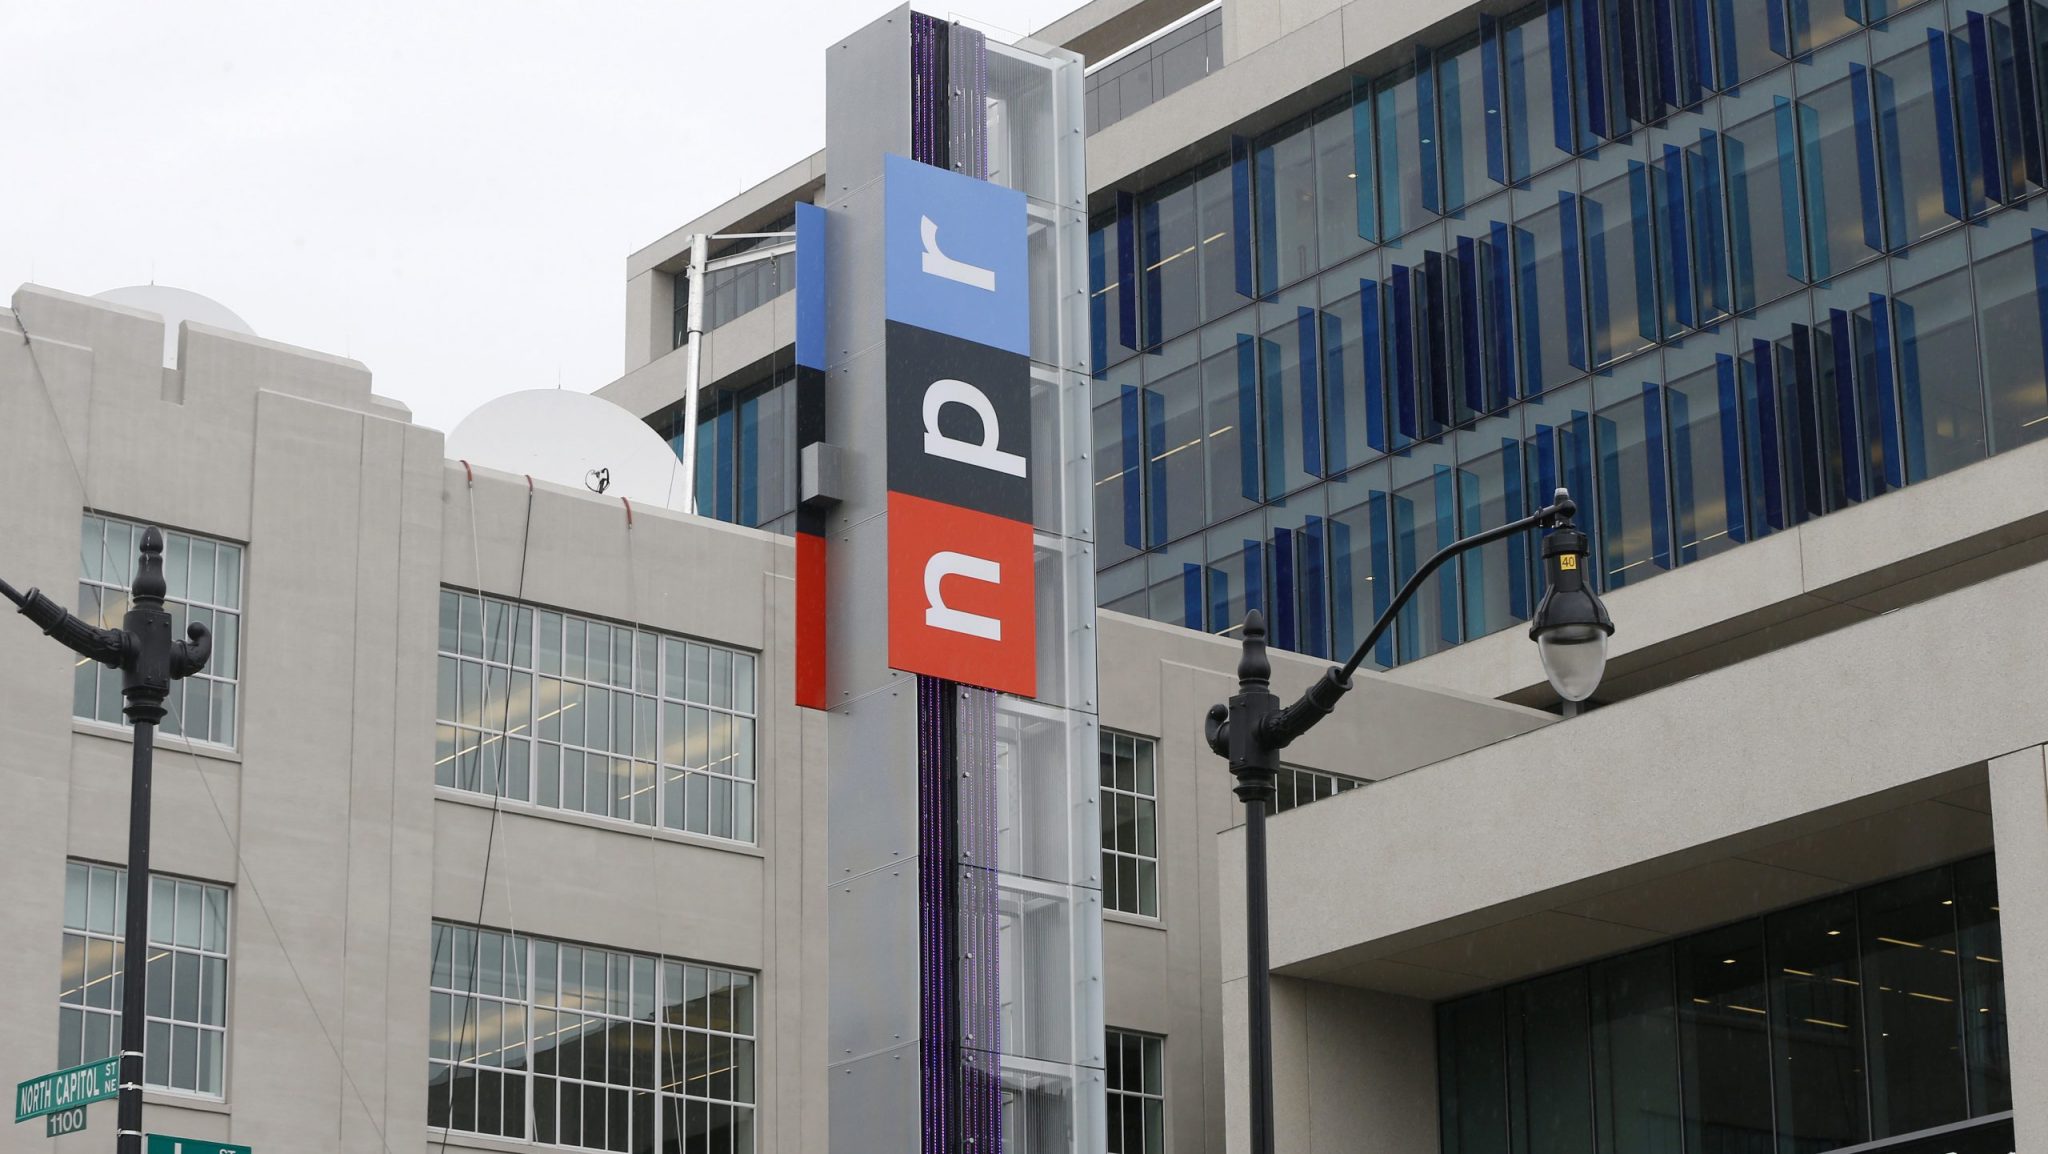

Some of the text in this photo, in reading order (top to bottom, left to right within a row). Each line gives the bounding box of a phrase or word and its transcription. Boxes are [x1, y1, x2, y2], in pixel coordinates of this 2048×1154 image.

[920, 214, 1027, 641] npr
[1562, 556, 1575, 567] 40
[105, 1062, 116, 1076] ST
[20, 1067, 100, 1115] NORTH CAPITOL
[104, 1079, 117, 1093] NE
[50, 1109, 83, 1134] 1100
